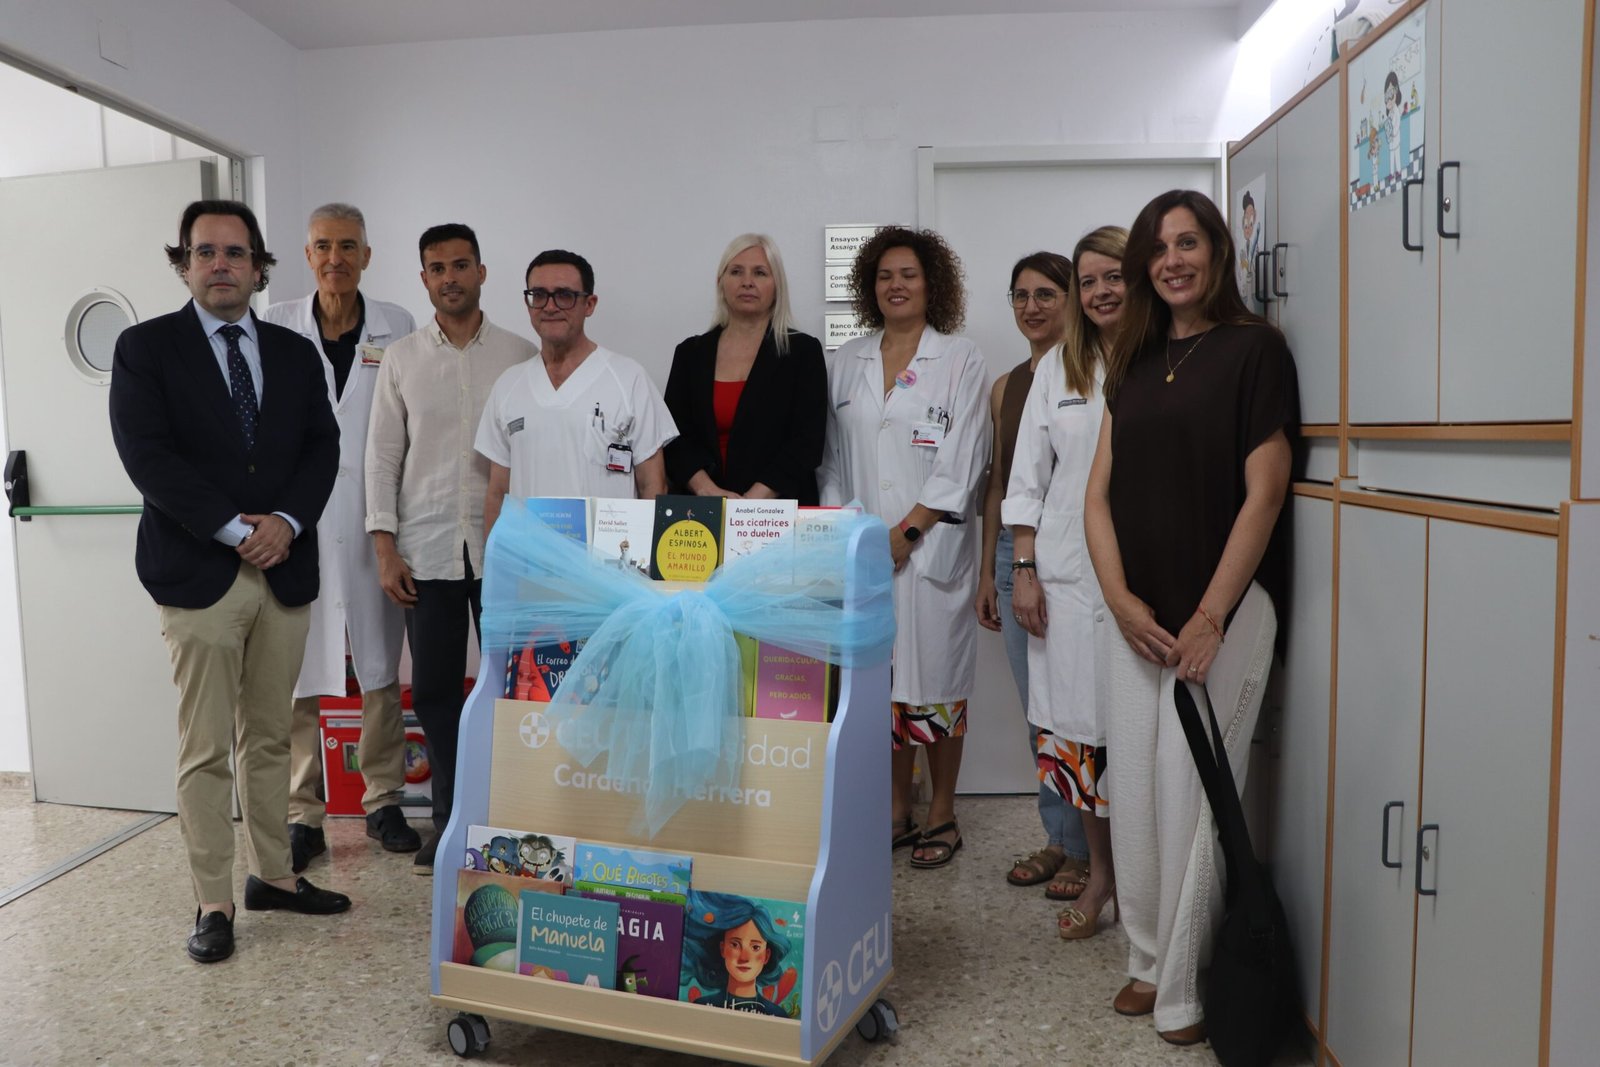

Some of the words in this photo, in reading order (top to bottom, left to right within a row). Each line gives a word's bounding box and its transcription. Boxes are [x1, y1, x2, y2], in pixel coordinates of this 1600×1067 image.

[735, 506, 756, 514] Anabel
[730, 517, 745, 527] Las
[746, 516, 790, 528] cicatrices
[673, 528, 704, 538] ALBERT
[750, 528, 780, 539] duelen
[668, 538, 708, 549] ESPINOSA
[667, 551, 677, 560] EL
[679, 551, 707, 561] MUNDO
[667, 562, 706, 573] AMARILLO
[536, 653, 544, 665] El
[546, 657, 569, 666] correo
[763, 655, 795, 665] QUERIDA
[769, 690, 788, 700] PERO
[531, 906, 544, 921] El
[545, 909, 591, 929] chupete
[593, 915, 608, 931] de
[616, 915, 665, 942] AGIA
[530, 925, 606, 953] Manuela
[847, 911, 889, 996] CEU
